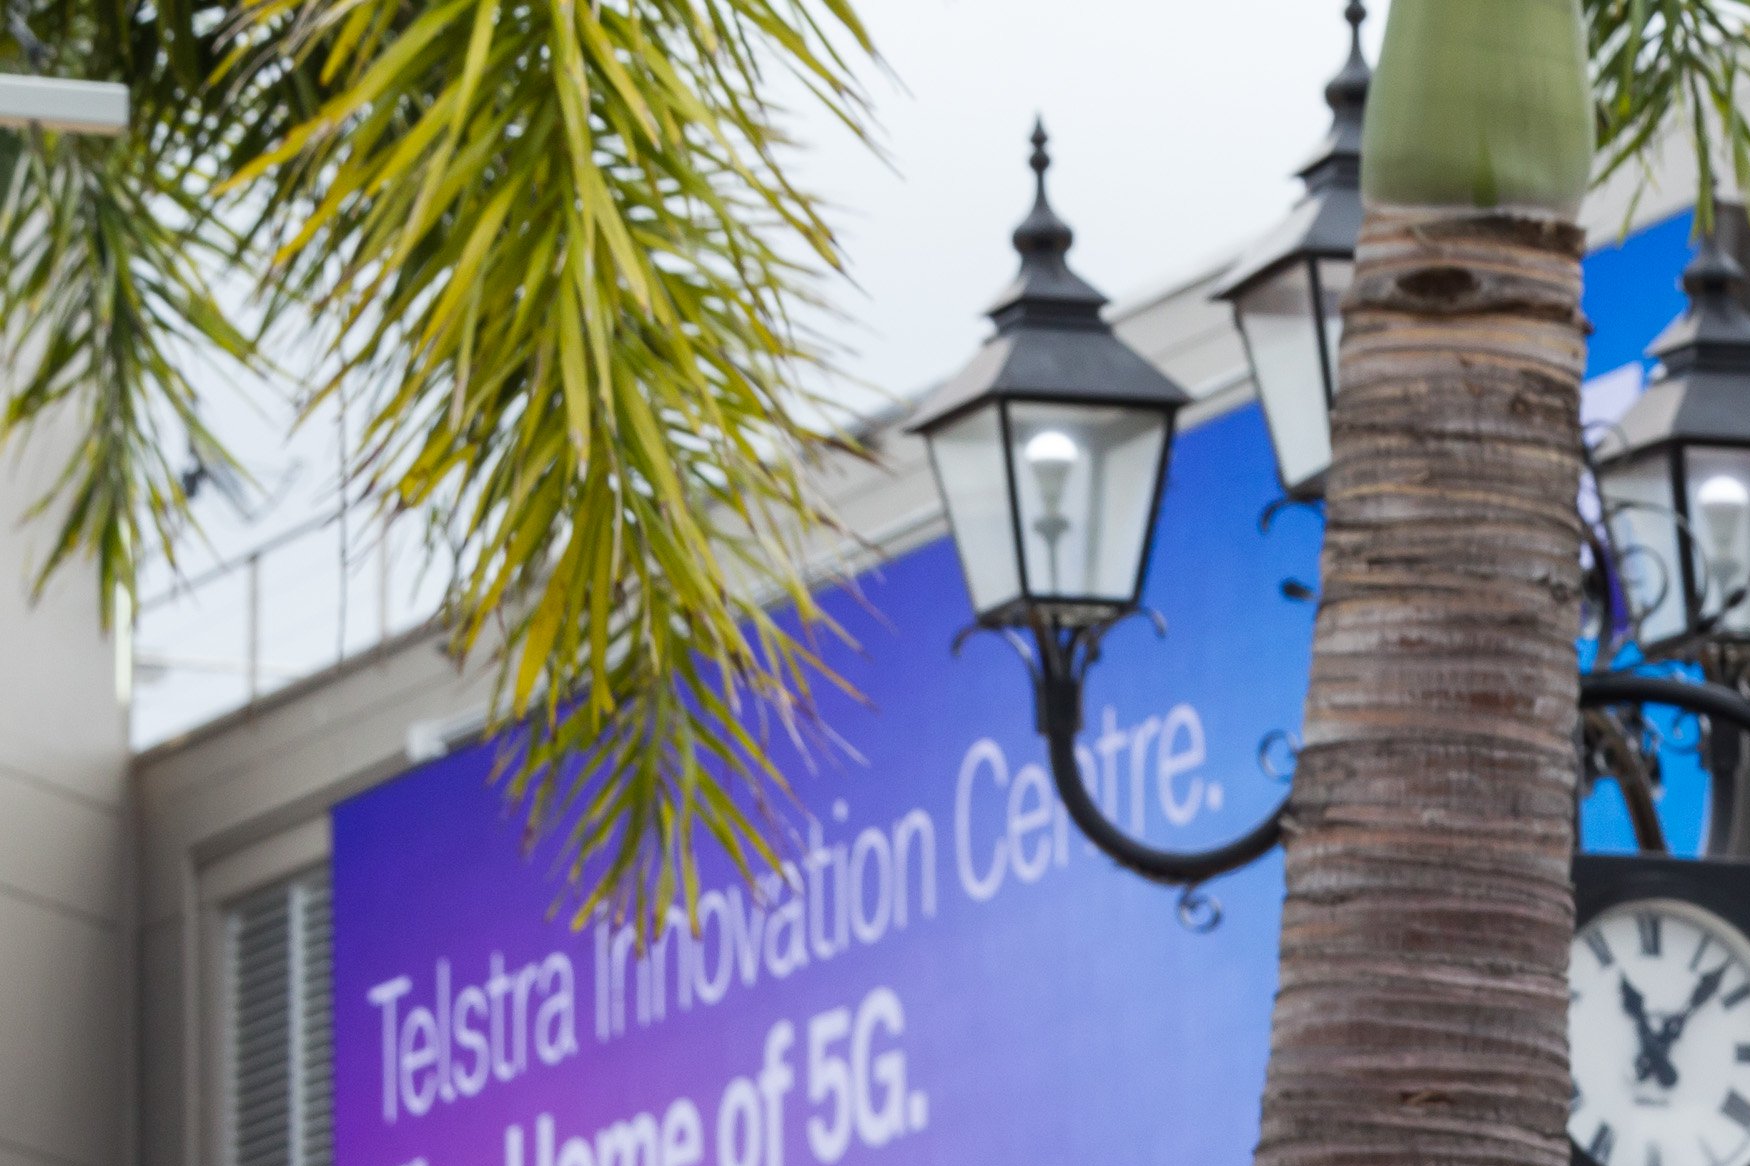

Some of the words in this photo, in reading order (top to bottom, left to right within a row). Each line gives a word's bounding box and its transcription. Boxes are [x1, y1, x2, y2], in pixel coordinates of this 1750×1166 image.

[367, 951, 578, 1124] Telstra
[594, 799, 936, 1043] Innovation
[806, 986, 929, 1164] 5G.
